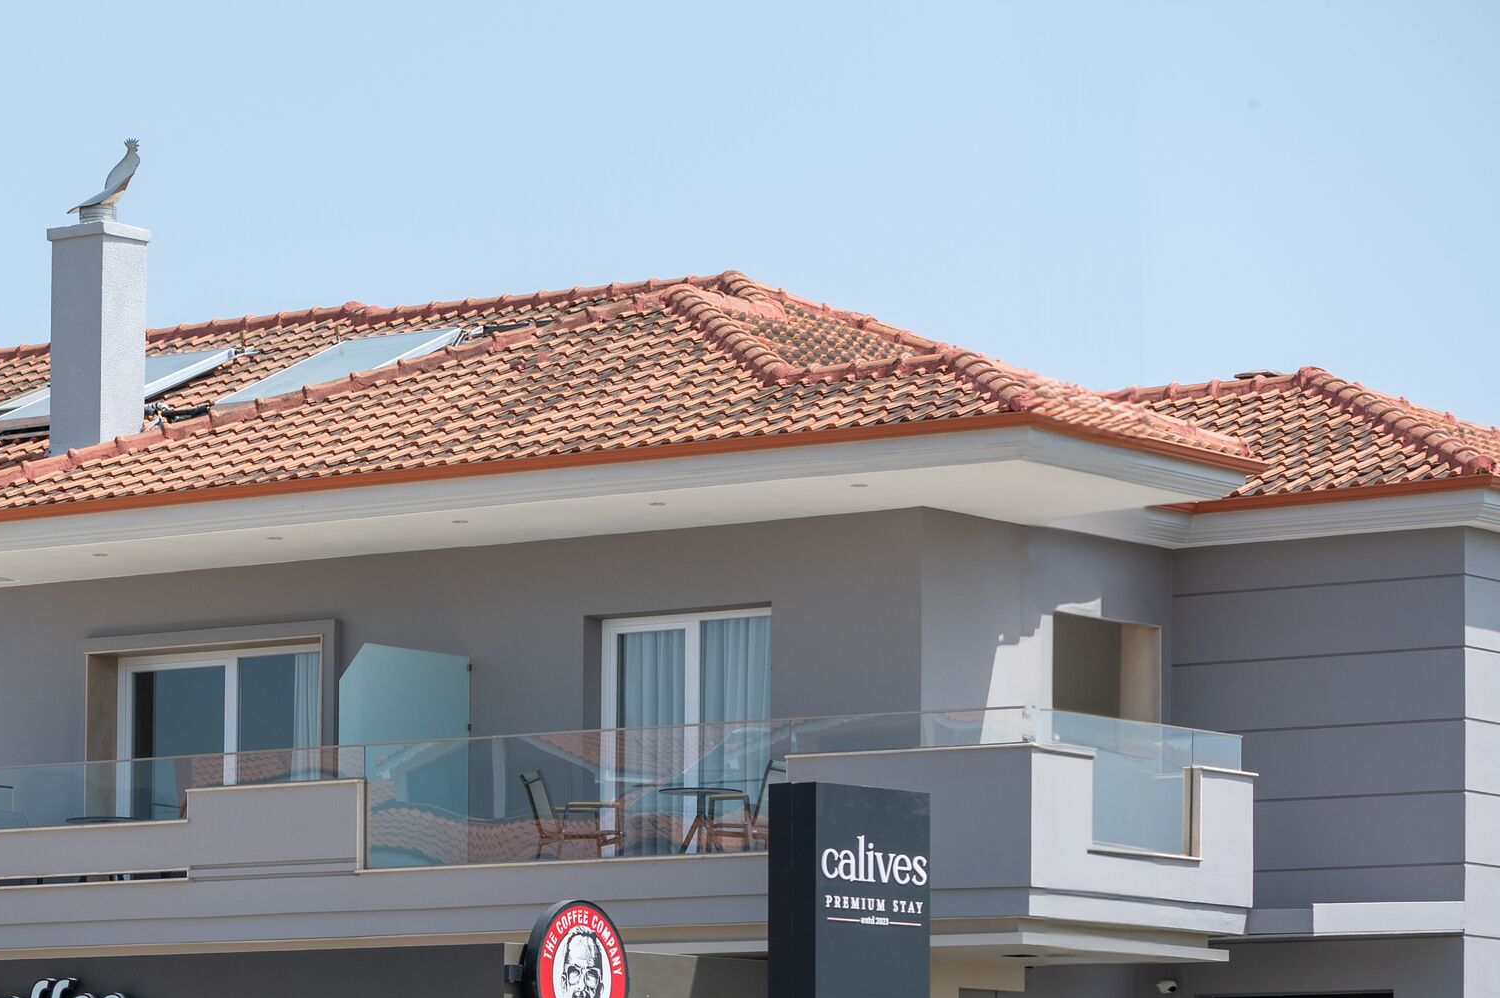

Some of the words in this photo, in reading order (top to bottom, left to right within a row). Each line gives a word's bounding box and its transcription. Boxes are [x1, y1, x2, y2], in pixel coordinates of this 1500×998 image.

[821, 835, 927, 886] calives
[825, 895, 885, 911] PREMIUM
[893, 900, 923, 914] STAY
[543, 932, 558, 959] THE
[556, 910, 589, 934] COFFEE
[591, 915, 623, 976] COMPANY
